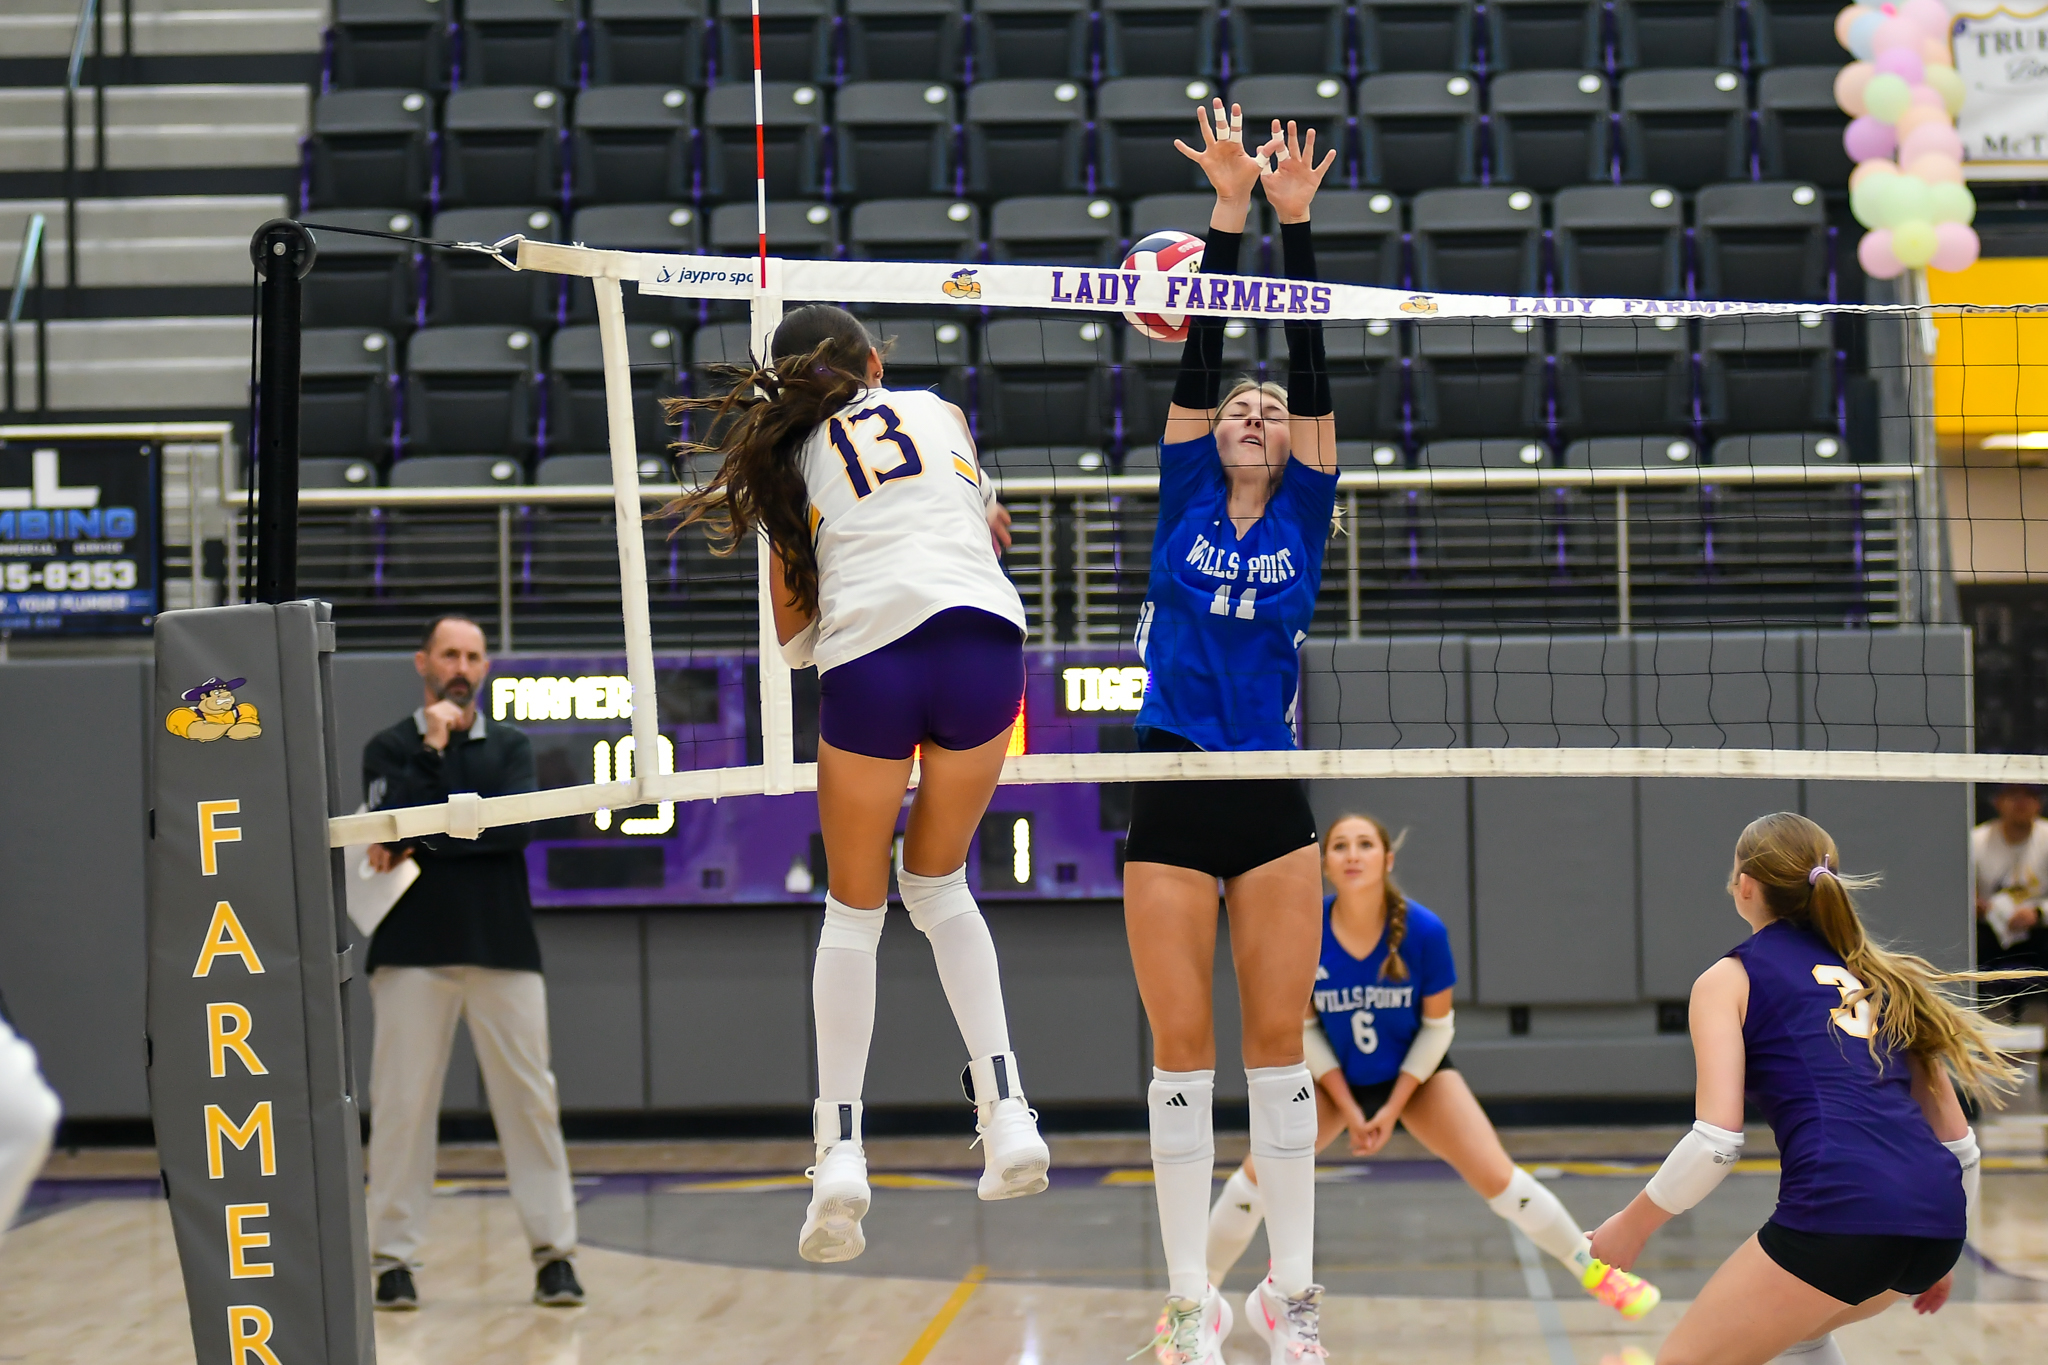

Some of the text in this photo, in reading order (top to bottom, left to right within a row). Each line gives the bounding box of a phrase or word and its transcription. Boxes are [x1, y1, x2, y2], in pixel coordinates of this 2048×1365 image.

[677, 266, 727, 284] jaypro
[1051, 271, 1332, 314] LADY FARMERS
[1507, 298, 1789, 315] LADY FARMERS
[828, 403, 926, 502] 13
[0, 449, 100, 508] L
[0, 559, 137, 592] 5-8353
[1186, 533, 1296, 584] WILLS POINT
[1210, 584, 1258, 620] 11
[1365, 985, 1414, 1010] POINT
[1811, 964, 1879, 1039] 3
[1351, 1010, 1379, 1054] 6
[192, 799, 282, 1365] FARMER
